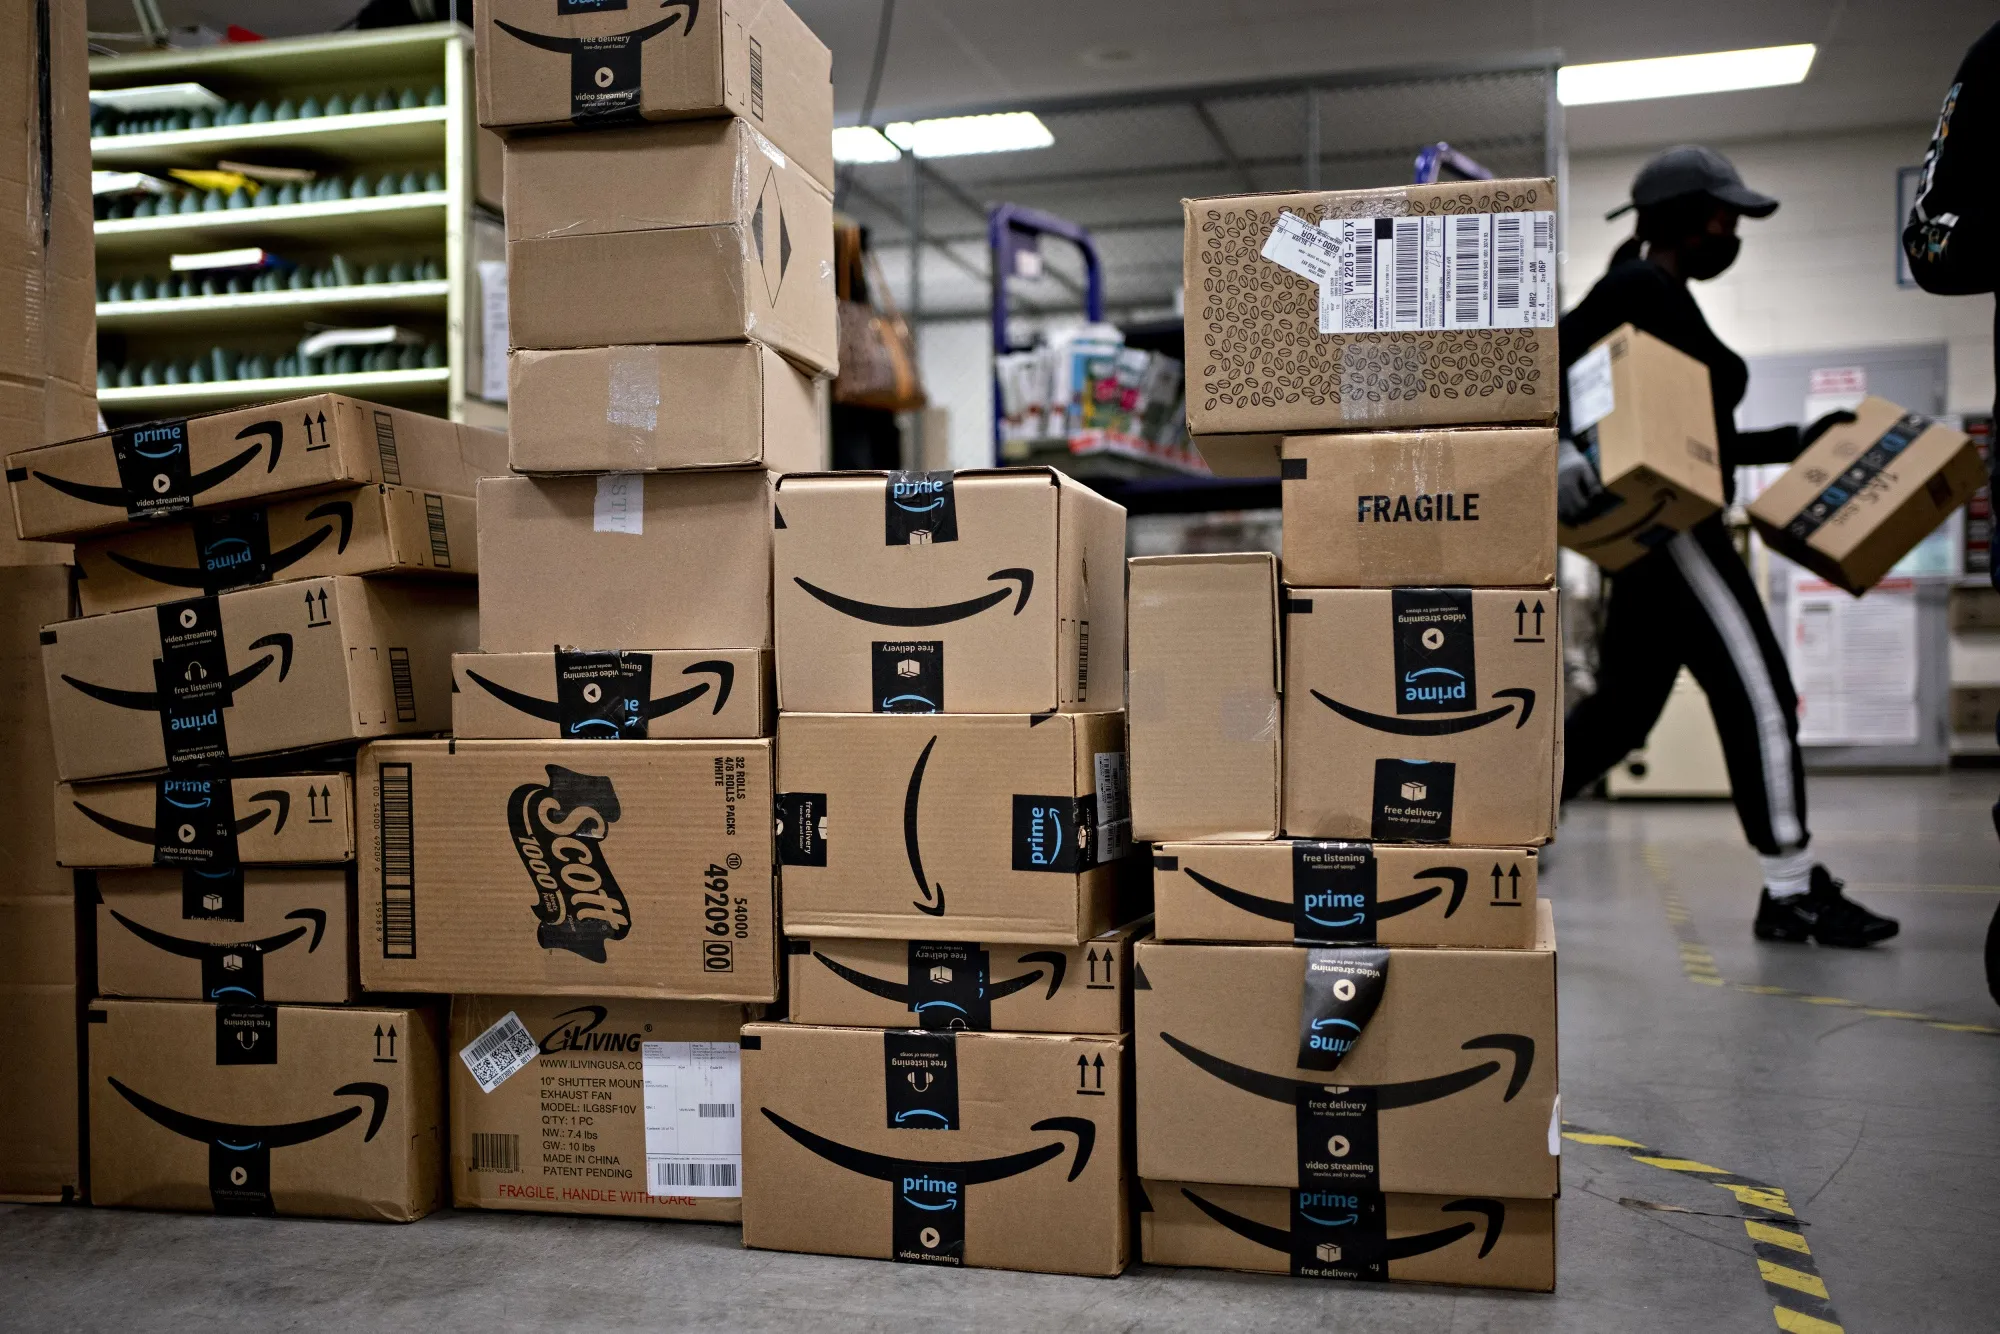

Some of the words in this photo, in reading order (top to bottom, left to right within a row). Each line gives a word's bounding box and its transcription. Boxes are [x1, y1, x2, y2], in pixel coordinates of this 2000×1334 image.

[597, 91, 633, 100] streaming
[1344, 261, 1354, 278] 220
[1529, 261, 1537, 273] AM
[1344, 281, 1354, 293] VA
[1529, 292, 1537, 308] MR2
[134, 427, 181, 447] prime
[893, 480, 943, 498] prime
[136, 499, 155, 507] video
[155, 495, 190, 505] streaming
[1358, 493, 1480, 522] FRAGILE
[207, 548, 252, 571] prime
[1398, 615, 1441, 624] streaming
[1443, 614, 1466, 623] video
[164, 635, 183, 643] video
[184, 629, 217, 640] streaming
[882, 644, 916, 653] delivery
[918, 645, 934, 653] free
[563, 671, 599, 681] streaming
[600, 670, 619, 679] video
[174, 686, 189, 694] free
[190, 681, 222, 692] listening
[1405, 681, 1466, 705] prime
[171, 709, 218, 731] prime
[172, 753, 206, 762] streaming
[206, 750, 225, 759] video
[725, 757, 735, 772] 4/8
[736, 757, 745, 769] 32
[714, 757, 724, 787] WHITE
[164, 779, 211, 794] prime
[725, 774, 735, 803] ROLLS
[736, 770, 746, 800] ROLLS
[805, 801, 813, 818] free
[1384, 805, 1402, 814] free
[1404, 807, 1442, 819] delivery
[373, 803, 381, 830] 54000
[726, 805, 736, 836] PACKS
[804, 820, 813, 854] delivery
[1028, 807, 1048, 865] prime
[160, 846, 178, 854] video
[179, 848, 213, 857] streaming
[518, 834, 558, 890] 1000
[538, 797, 629, 931] Scott
[1303, 854, 1321, 862] free
[1324, 854, 1365, 864] listening
[704, 863, 731, 937] 49209
[1304, 889, 1365, 912] prime
[734, 897, 748, 939] 54000
[706, 943, 731, 970] 00
[915, 950, 949, 960] delivery
[950, 952, 967, 961] free
[1311, 963, 1355, 975] streaming
[1356, 968, 1380, 978] video
[224, 1018, 255, 1027] listening
[540, 1060, 643, 1070] WWW.ILIVINGUSA.CO
[892, 1058, 928, 1068] listening
[931, 1060, 947, 1069] free
[558, 1078, 606, 1087] SHUTTER
[541, 1090, 588, 1100] EXHAUST
[592, 1091, 612, 1100] FAN
[541, 1102, 580, 1112] MODEL:
[583, 1104, 637, 1114] ILG8SF10V
[1309, 1100, 1327, 1108] free
[1329, 1101, 1367, 1111] delivery
[572, 1117, 576, 1125] 1
[579, 1117, 594, 1126] PC
[568, 1130, 581, 1139] 7.4
[584, 1131, 598, 1140] lbs
[569, 1142, 579, 1151] 10
[582, 1143, 596, 1152] lbs
[543, 1154, 572, 1163] MADE
[575, 1155, 585, 1164] IN
[588, 1155, 620, 1165] CHINA
[543, 1166, 583, 1176] PATENT
[586, 1168, 633, 1178] PENDING
[1305, 1161, 1329, 1169] video
[1331, 1162, 1374, 1172] streaming
[903, 1174, 957, 1194] prime
[499, 1184, 559, 1200] FRAGILE,
[563, 1188, 616, 1202] HANDLE
[620, 1191, 655, 1204] WITH
[1300, 1189, 1359, 1209] prime
[899, 1250, 920, 1260] video
[921, 1253, 959, 1265] streaming
[1301, 1266, 1319, 1276] free
[1321, 1268, 1358, 1279] delivery
